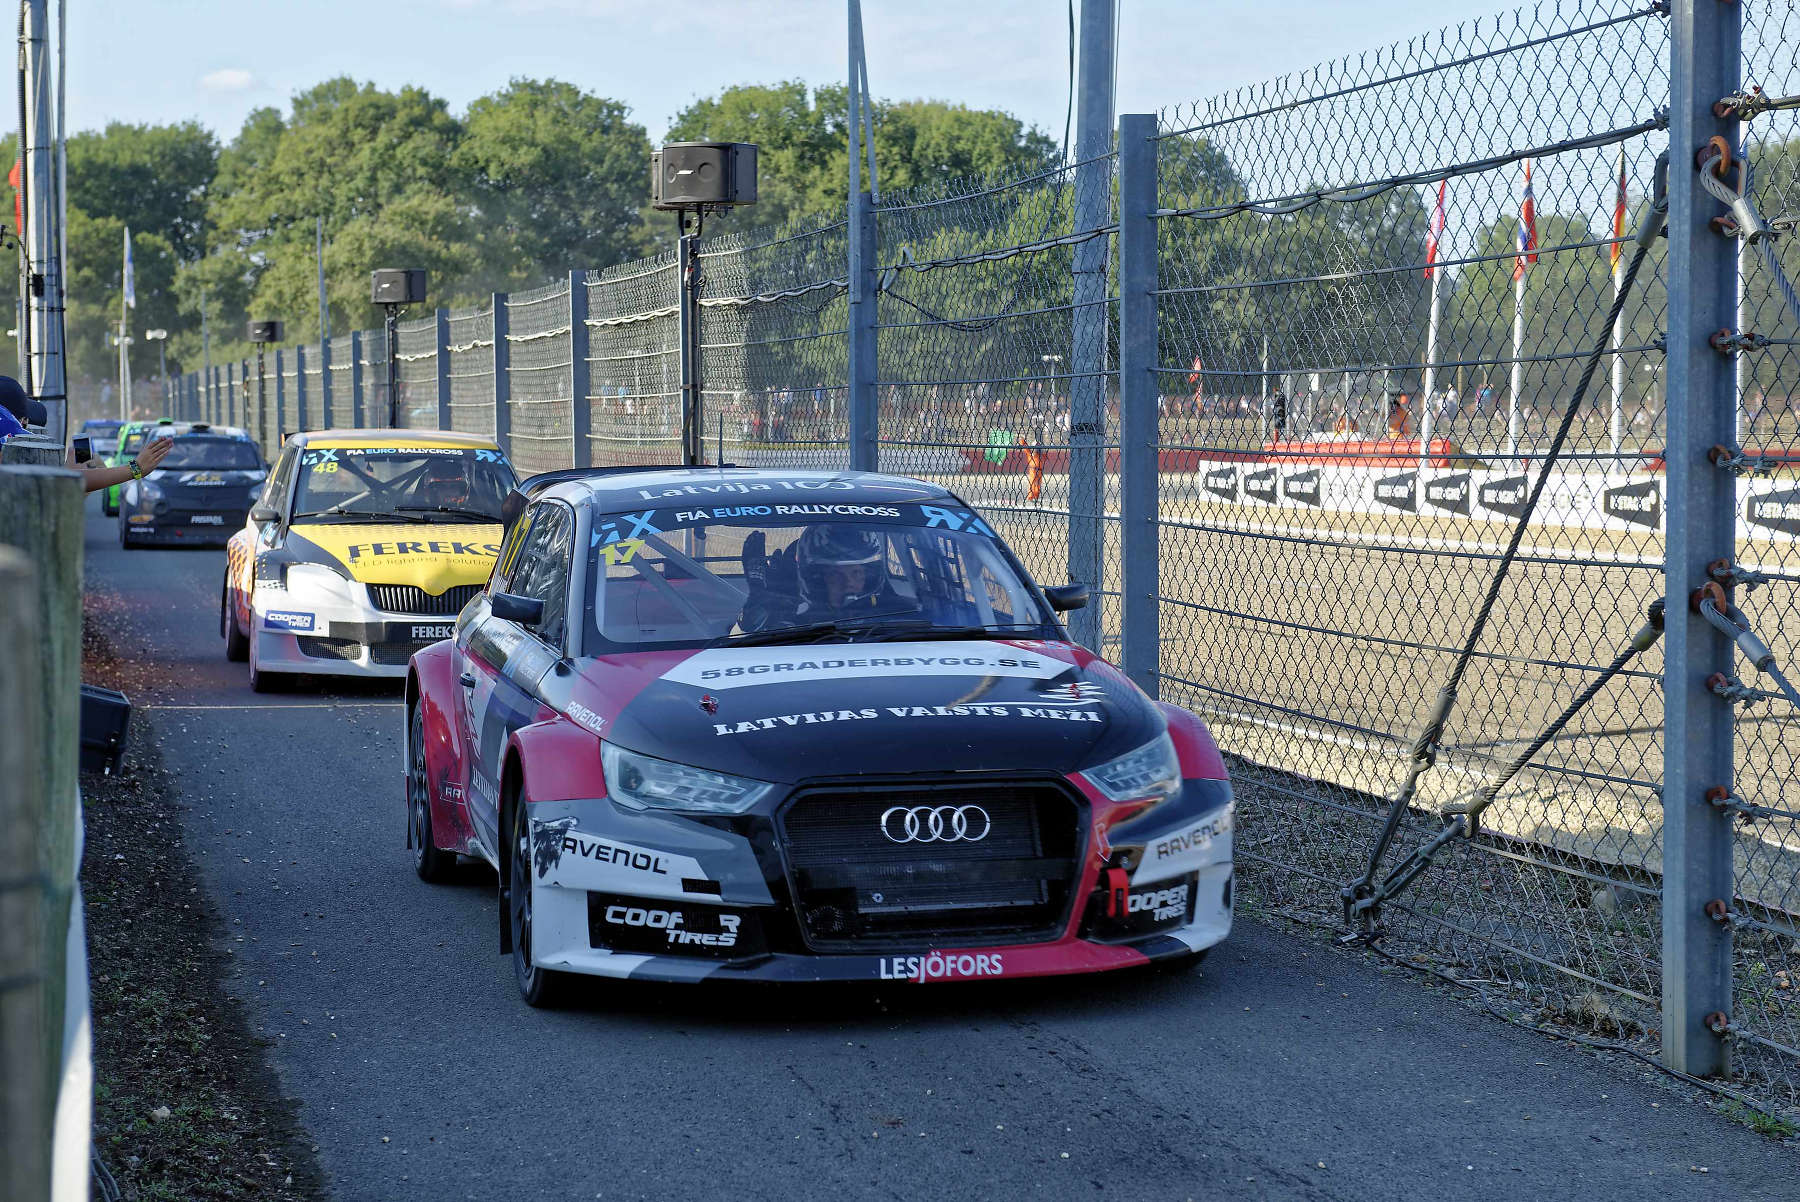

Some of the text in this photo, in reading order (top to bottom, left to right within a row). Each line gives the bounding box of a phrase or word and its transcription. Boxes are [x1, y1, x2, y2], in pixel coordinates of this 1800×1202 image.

[398, 448, 464, 456] RALLYCROSS
[312, 462, 339, 474] 48
[638, 482, 773, 501] Latvija
[674, 504, 901, 523] FIA EURO RALLYCROSS
[348, 541, 501, 562] FEREKS
[600, 539, 646, 566] 17
[268, 613, 312, 623] COOPER
[701, 657, 1042, 680] 58GRADERBYGG.SE
[566, 701, 606, 732] RAVENOL
[713, 708, 880, 736] LATVIJAS
[885, 705, 1010, 718] VALSTS
[563, 837, 668, 875] AVENOL
[1127, 884, 1189, 913] OOPER
[665, 928, 738, 947] TIRES
[879, 951, 1004, 984] LESJÖFORS
